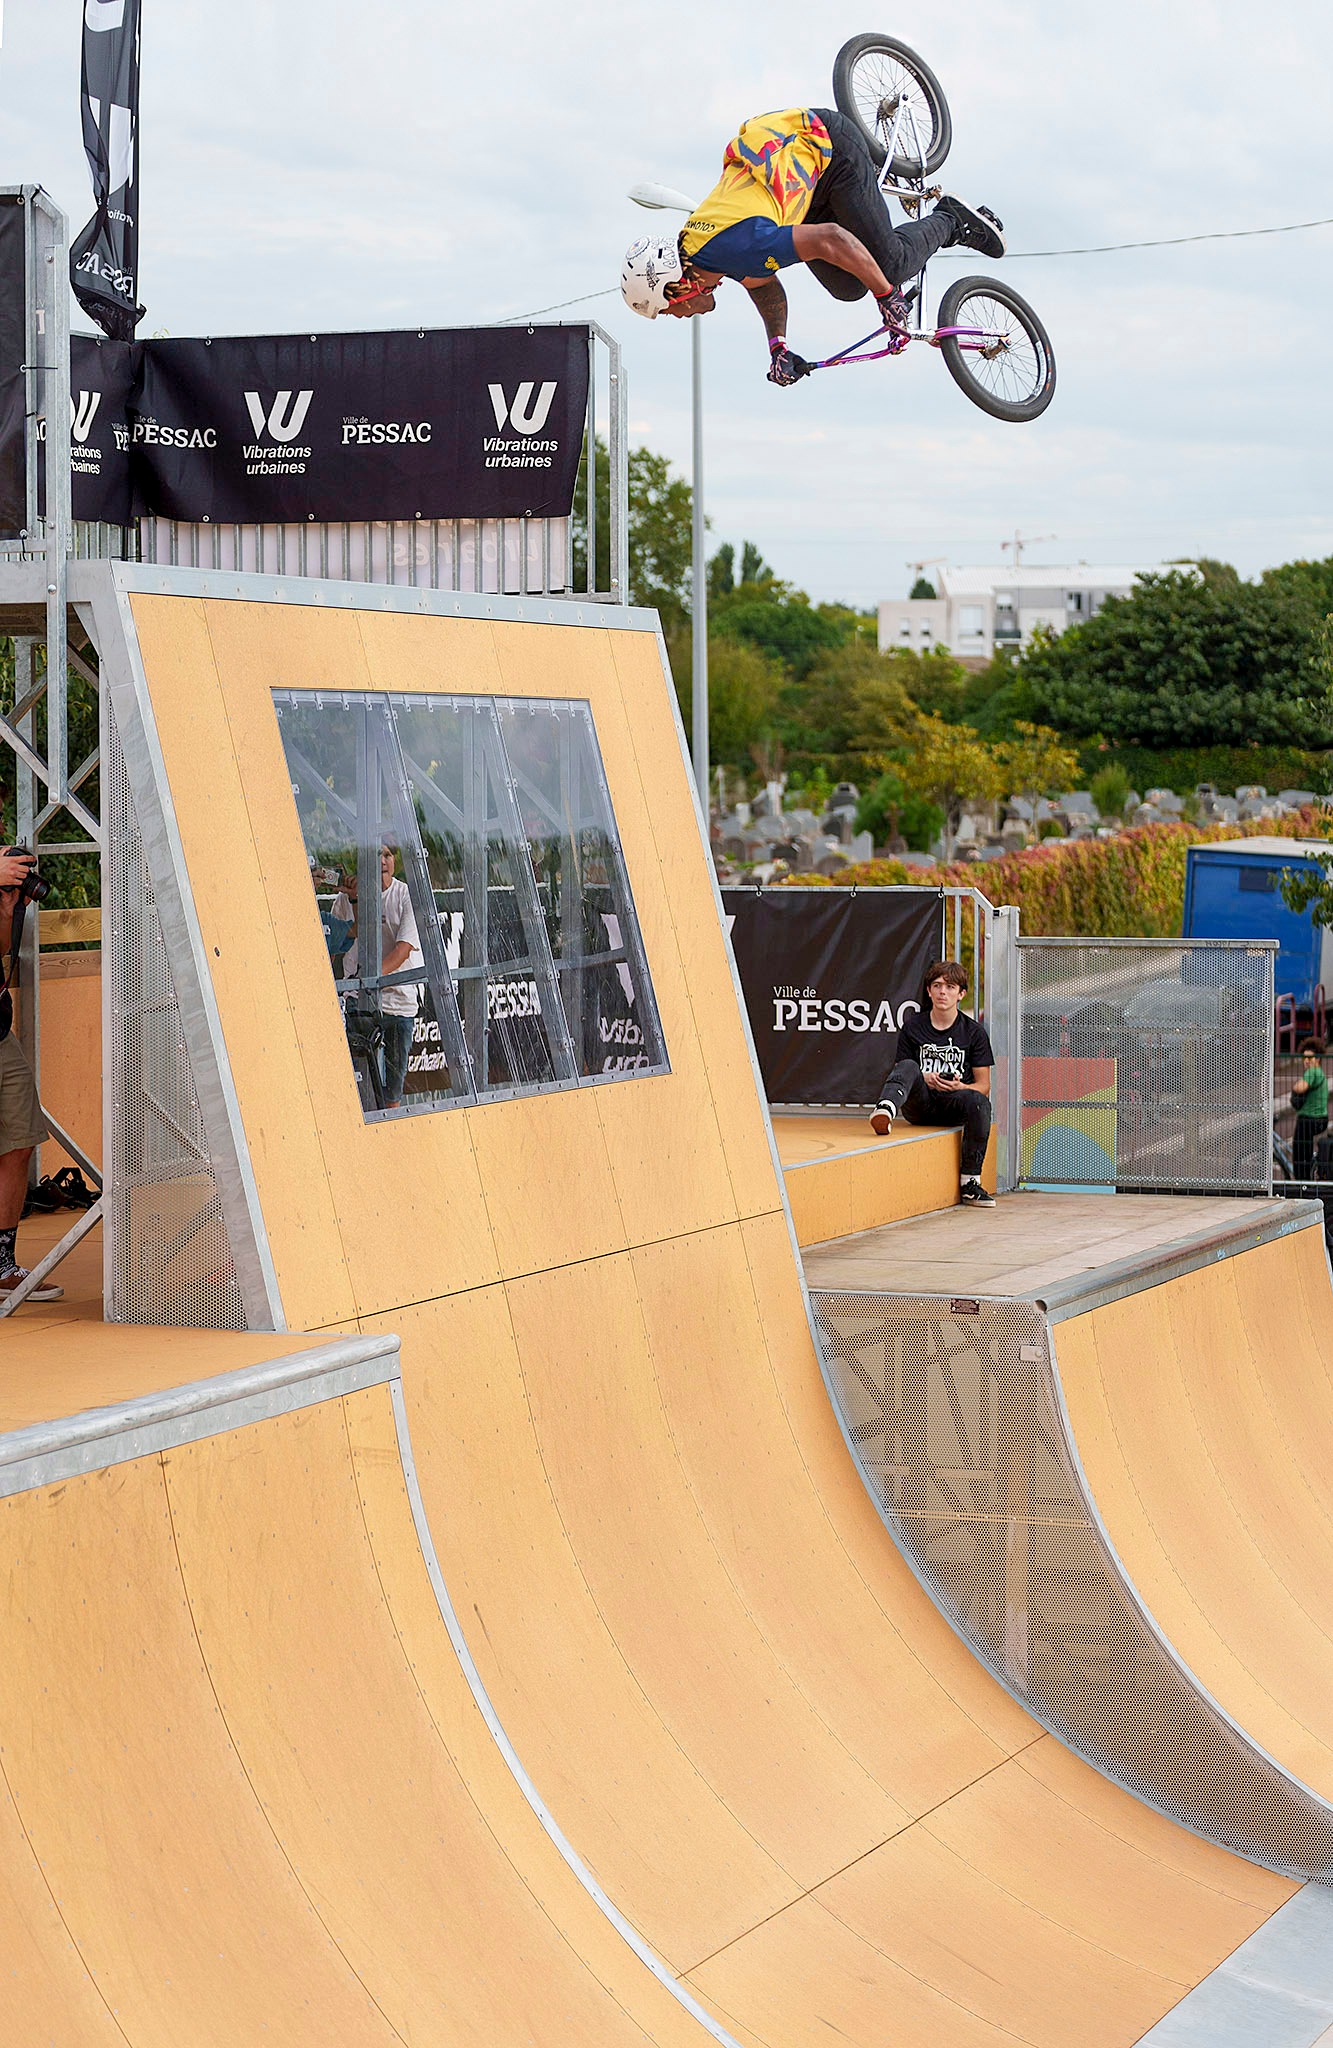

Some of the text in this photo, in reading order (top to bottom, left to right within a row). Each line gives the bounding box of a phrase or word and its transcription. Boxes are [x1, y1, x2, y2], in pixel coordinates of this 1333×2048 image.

[147, 416, 157, 425] de
[342, 415, 369, 425] Ville de
[131, 423, 218, 448] PESSAC
[341, 422, 432, 445] PESSAC
[242, 444, 312, 460] Vibrations
[482, 437, 559, 452] Vibrations
[246, 460, 306, 475] urbaines
[484, 453, 553, 468] urbaines
[773, 985, 817, 998] Ville de
[772, 998, 921, 1033] PESSAC
[922, 1057, 960, 1074] BMX
